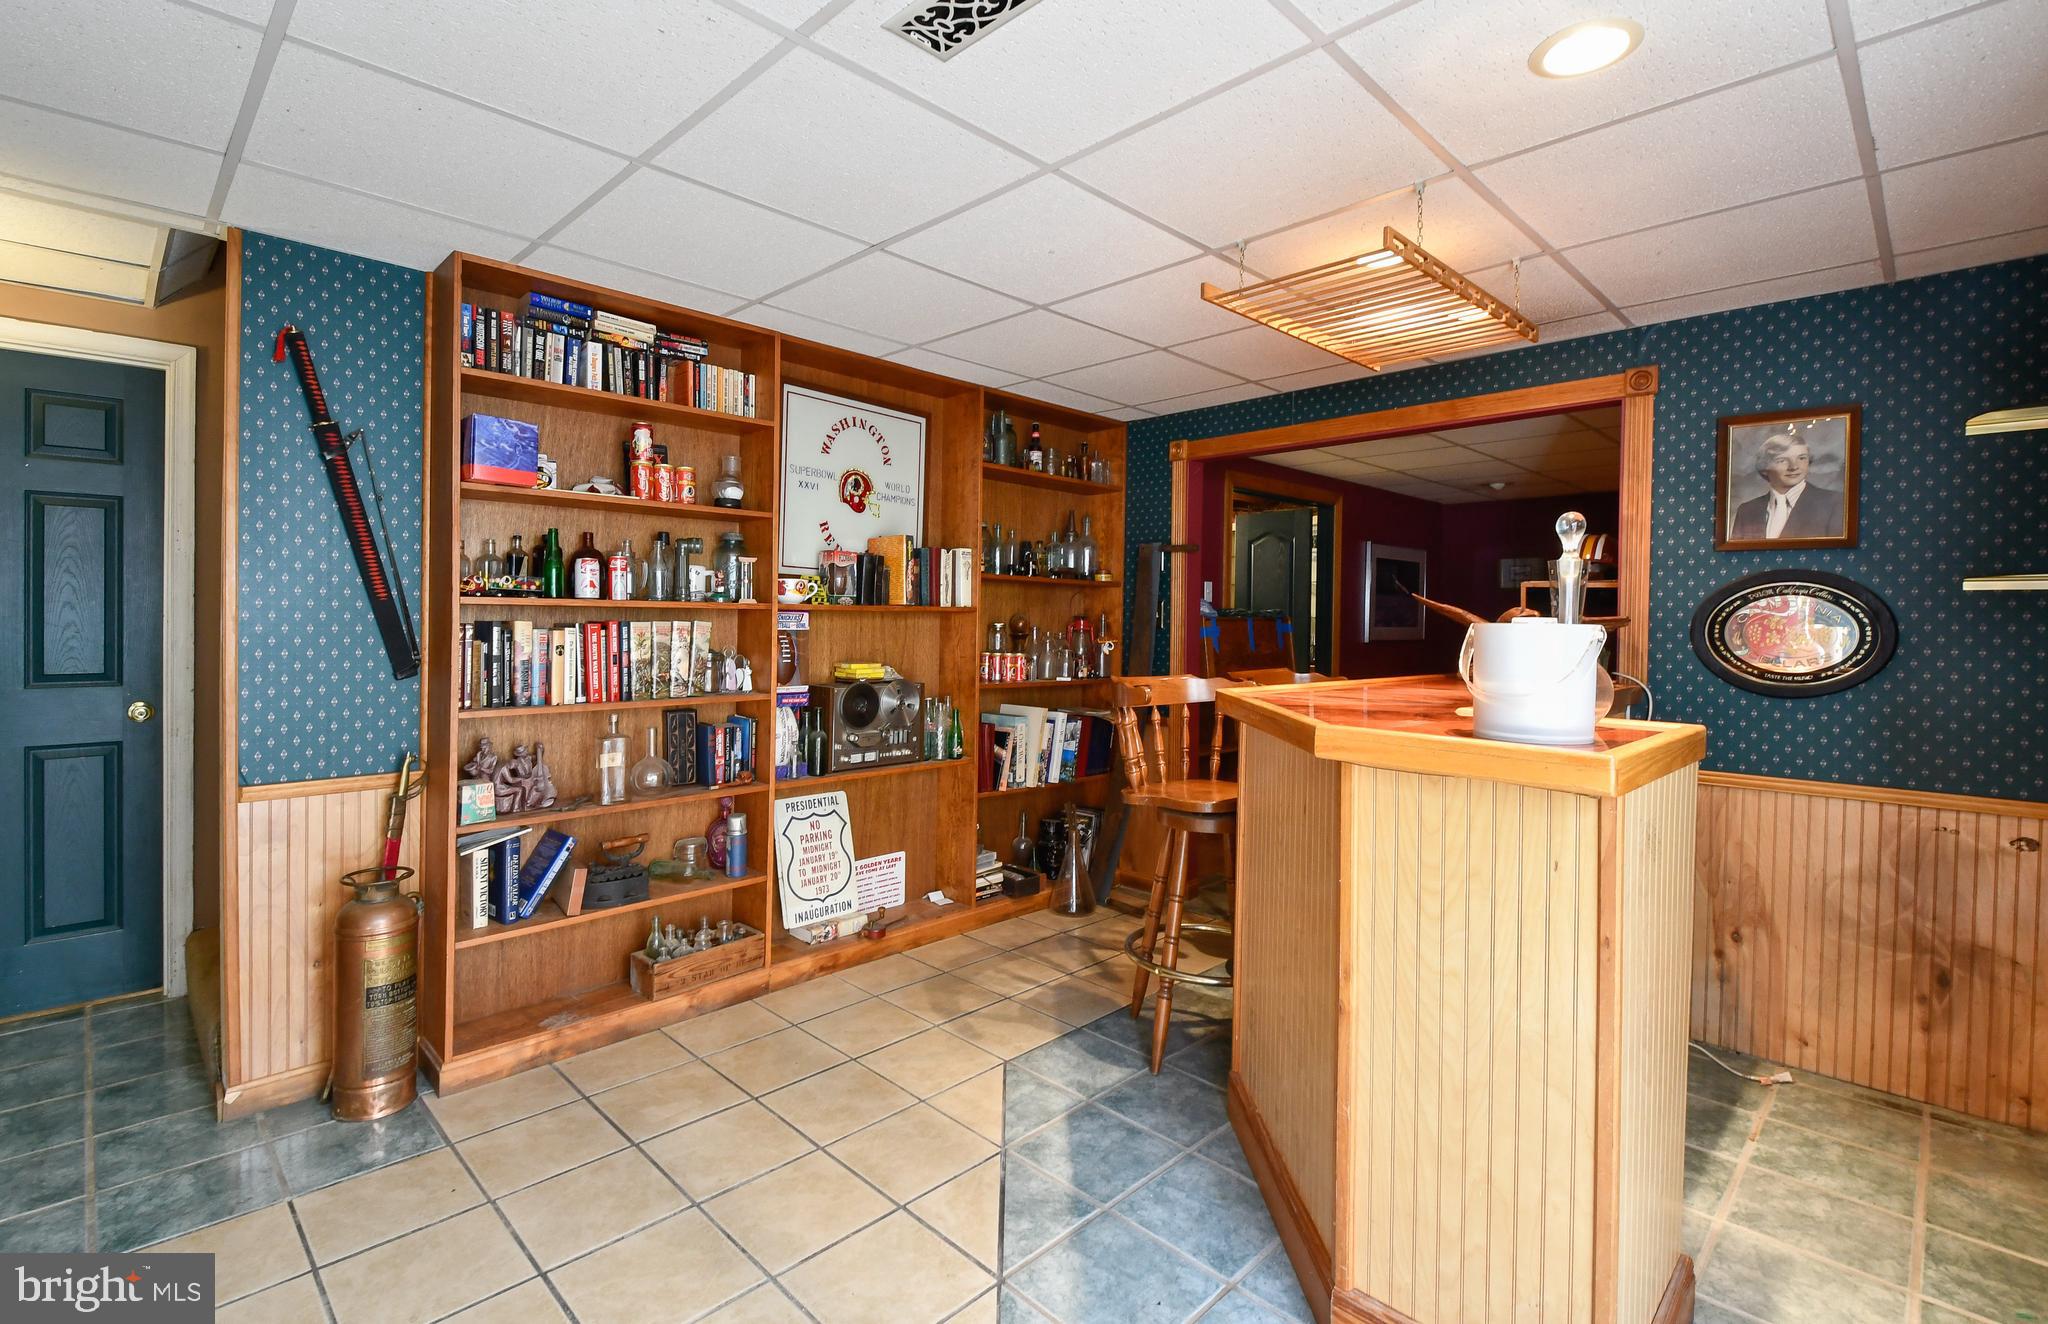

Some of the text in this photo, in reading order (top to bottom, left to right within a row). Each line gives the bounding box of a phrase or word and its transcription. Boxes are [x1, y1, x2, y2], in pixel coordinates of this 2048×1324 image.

[820, 416, 892, 467] WASHINGTON
[789, 463, 838, 482] SUPERBOWL
[798, 480, 819, 491] XXVI
[884, 481, 911, 494] WORLD
[876, 492, 916, 507] CHAMPIONS
[785, 795, 840, 813] PRESIDENTIAL
[809, 819, 821, 831] NO
[799, 830, 833, 845] PARKING
[802, 841, 833, 854] MIDNIGHT
[799, 854, 826, 867] JANUARY
[859, 861, 883, 871] GOLDEN
[883, 856, 902, 865] YEARS
[798, 868, 807, 878] TO
[811, 860, 842, 875] MIDNIGHT
[479, 857, 488, 917] SILENT VICTORY
[800, 875, 828, 889] JANUARY
[815, 886, 830, 896] 1973
[794, 900, 853, 924] INAUGURATION
